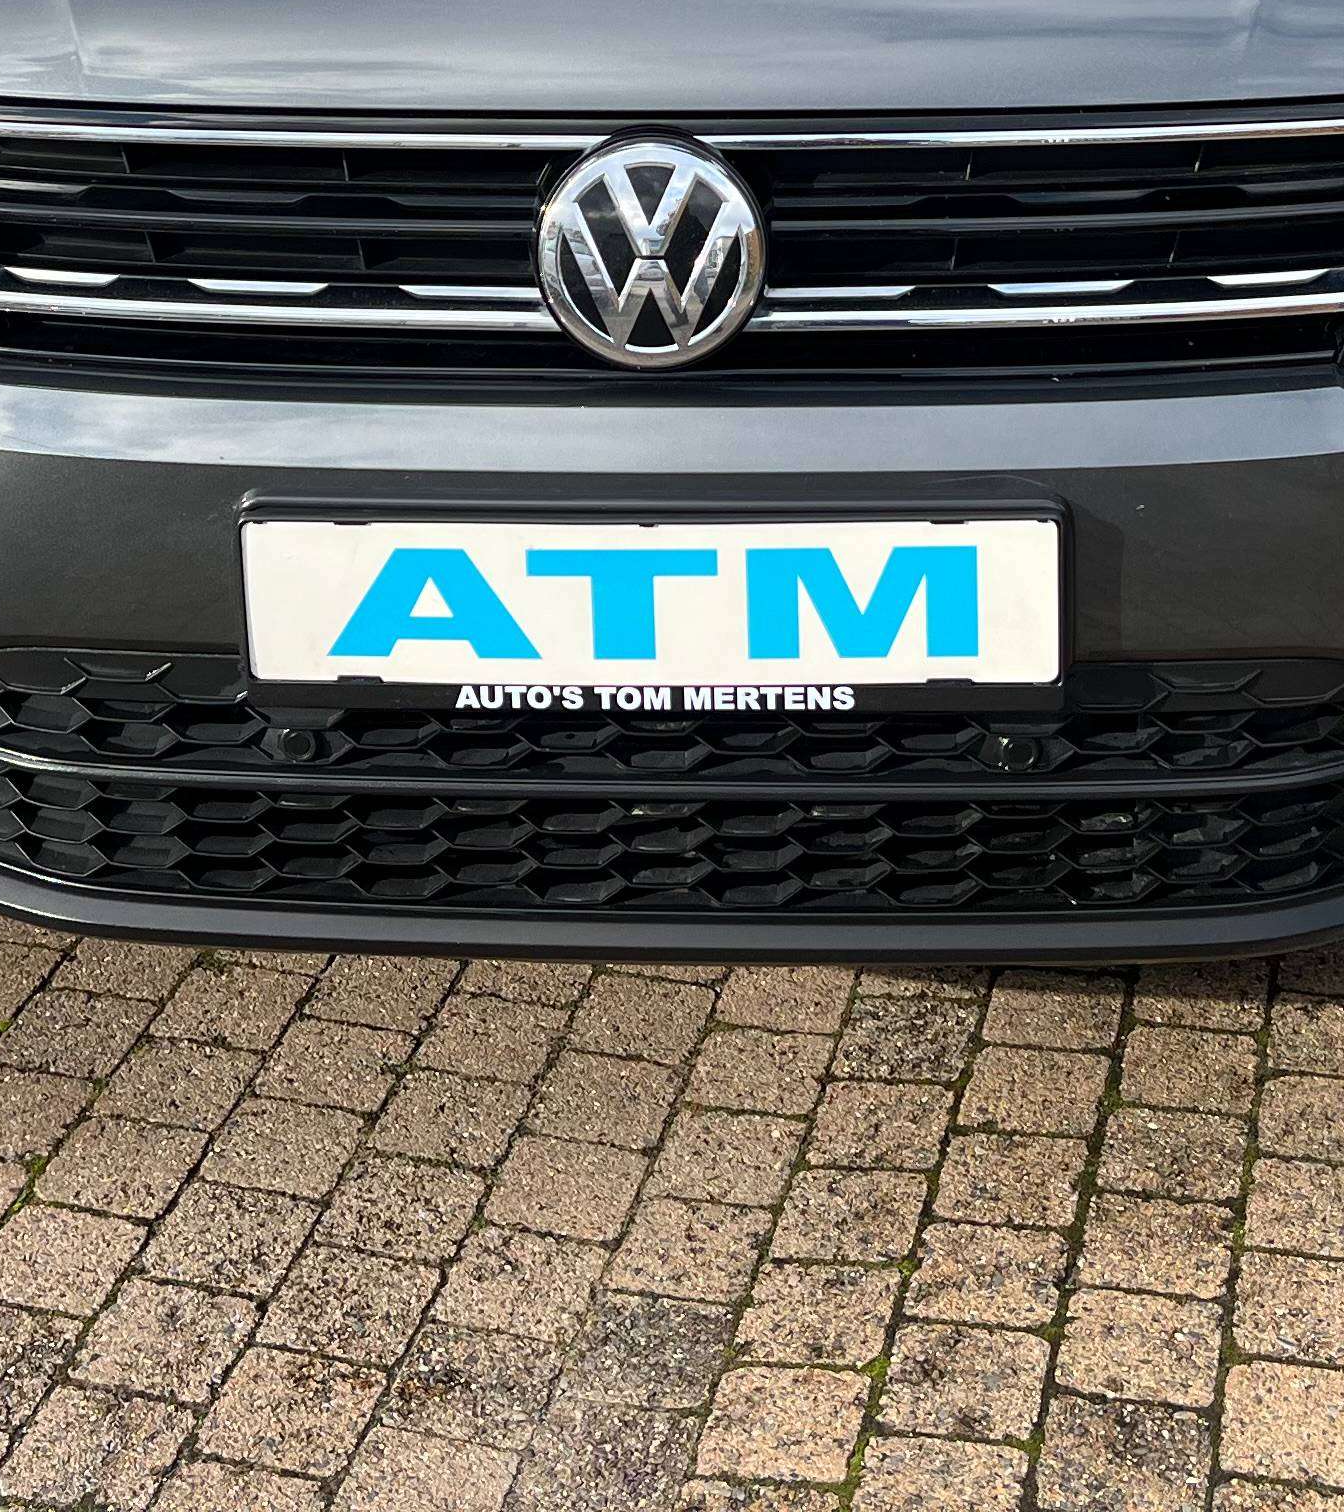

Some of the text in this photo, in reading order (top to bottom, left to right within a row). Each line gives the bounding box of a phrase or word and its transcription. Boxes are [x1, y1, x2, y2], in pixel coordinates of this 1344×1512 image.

[327, 546, 978, 660] ATM
[456, 685, 856, 711] AUTO'S TOM MERTENS
